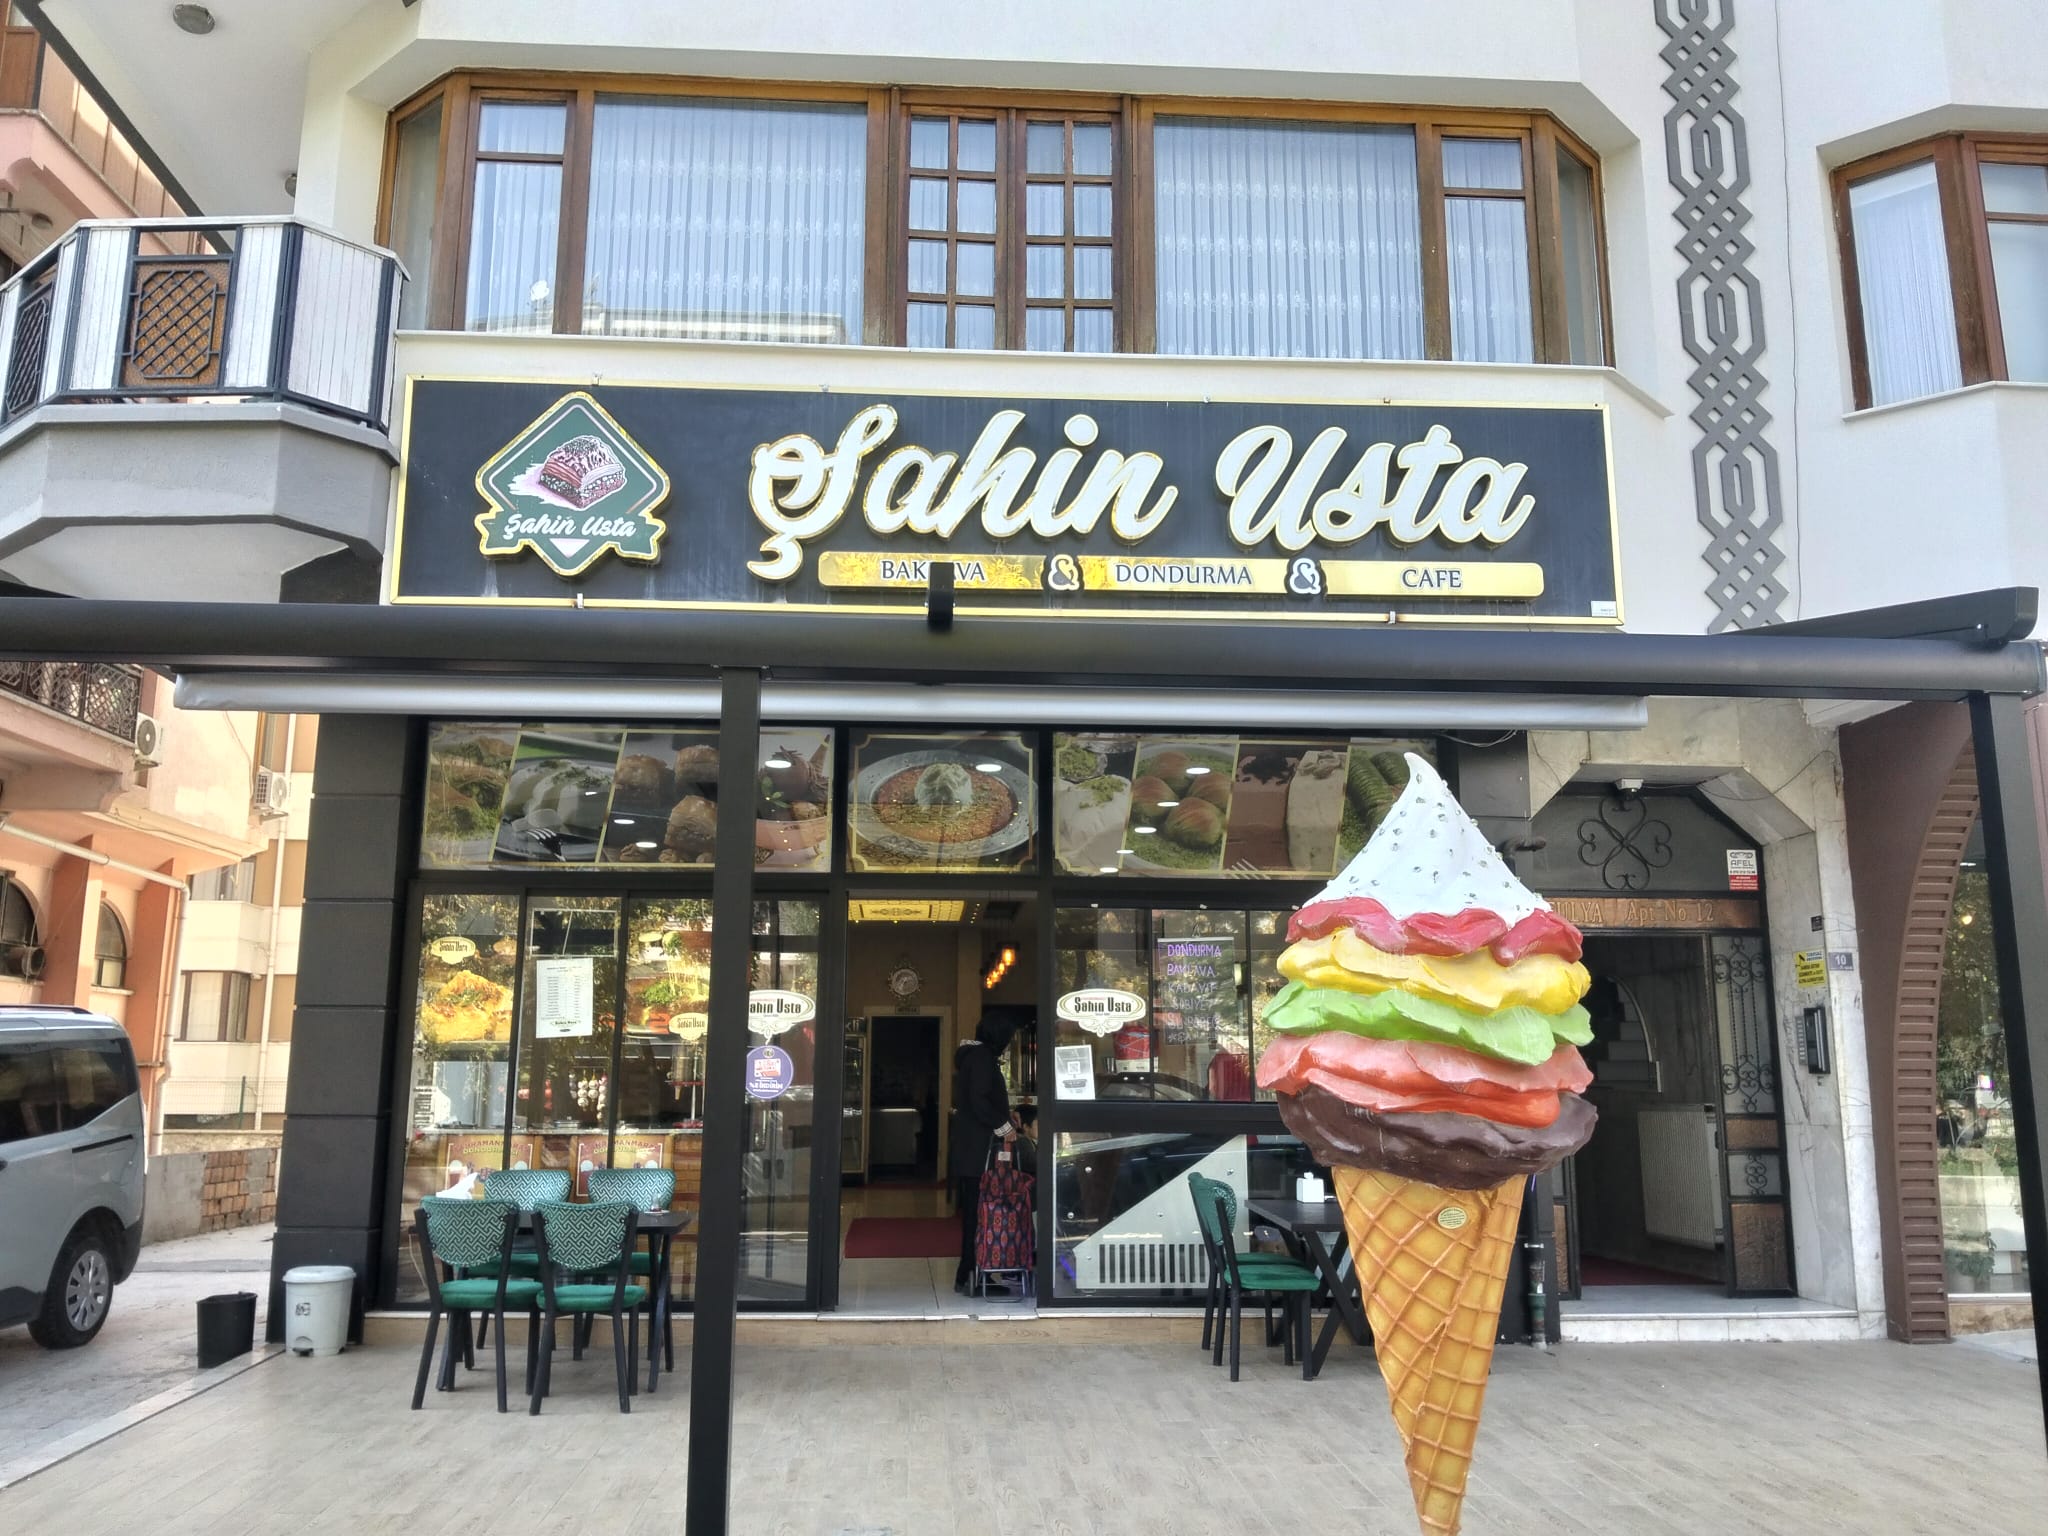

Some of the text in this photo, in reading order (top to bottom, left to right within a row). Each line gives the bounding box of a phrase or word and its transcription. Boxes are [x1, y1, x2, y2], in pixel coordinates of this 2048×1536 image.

[747, 403, 1536, 582] Şahin Usta
[503, 513, 636, 540] Şahin Usta
[881, 555, 1462, 594] BAKVA & DONDURMA & CAFE
[1549, 901, 1714, 926] ULYA Apt No 12
[1167, 944, 1222, 957] DONDURMA
[1835, 954, 1847, 966] 10
[776, 998, 802, 1014] Usta
[1107, 996, 1132, 1013] Usta
